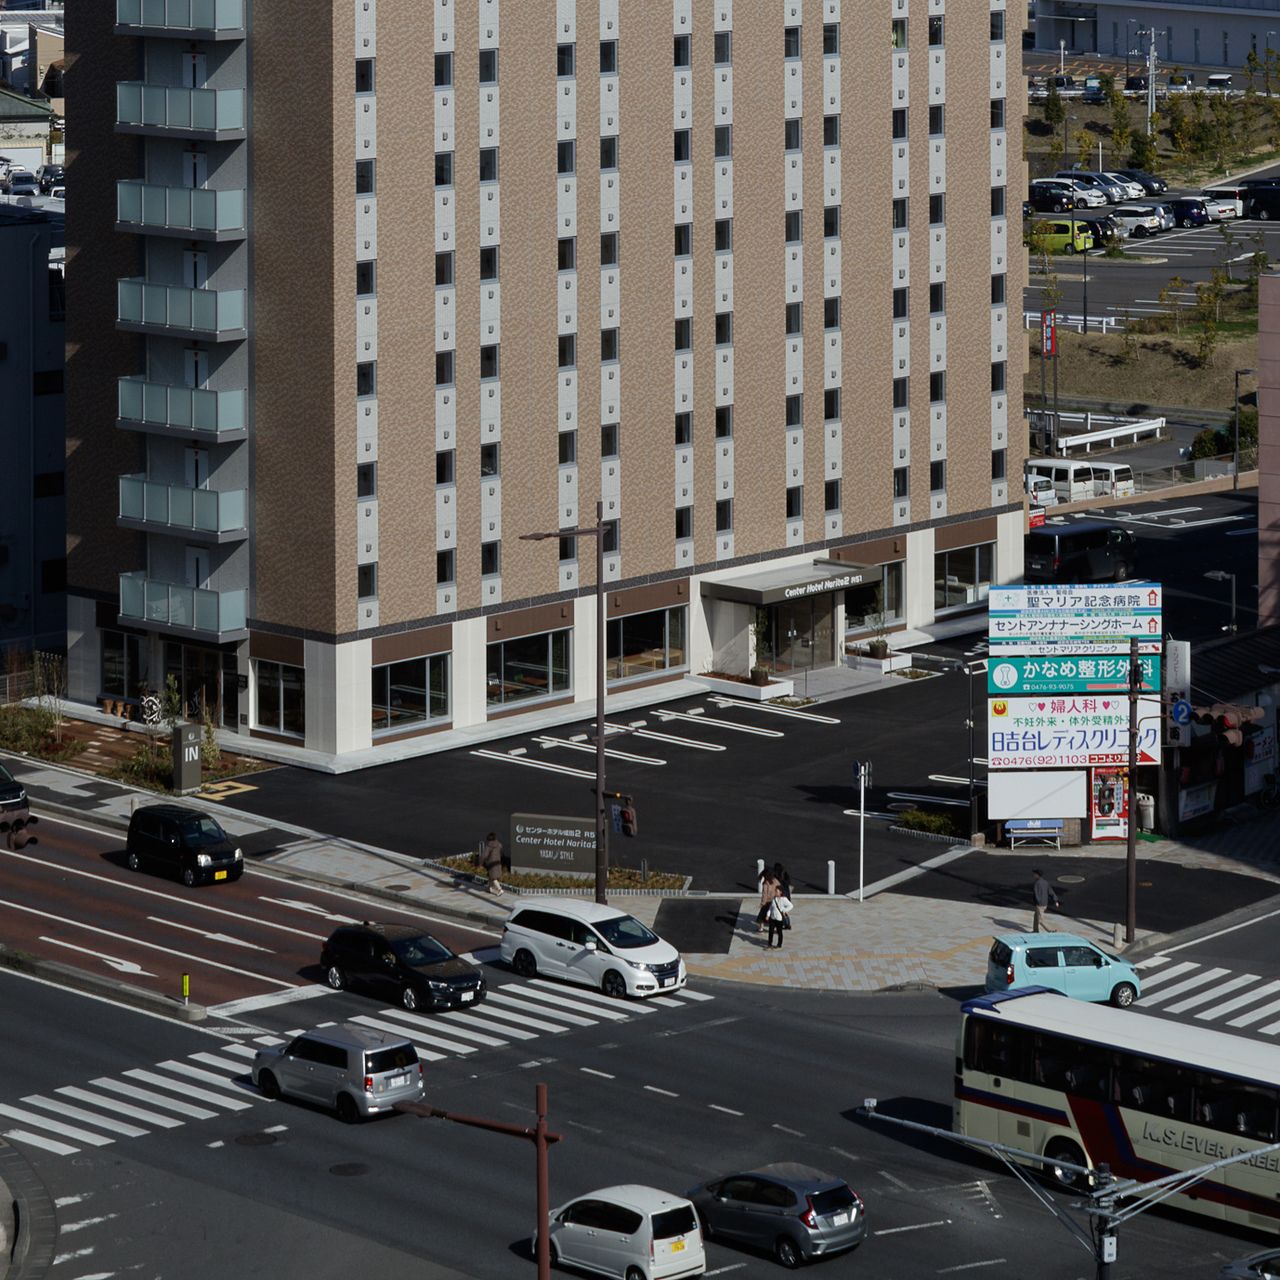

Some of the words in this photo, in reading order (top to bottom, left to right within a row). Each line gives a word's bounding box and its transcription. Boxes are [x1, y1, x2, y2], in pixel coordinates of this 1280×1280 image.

[785, 586, 806, 597] Center
[806, 582, 824, 593] Hotel
[1027, 595, 1141, 608] 聖マリア記念病院
[995, 619, 1142, 632] セントアンナナーシングホーム
[1038, 645, 1118, 654] セントマリアクリニック
[1023, 659, 1153, 679] かなめ整形外科
[1050, 699, 1097, 713] 婦人科
[1178, 704, 1188, 722] 2
[185, 745, 199, 762] IN
[1090, 754, 1142, 763] ココより車分
[1003, 755, 1088, 766] 0476(92)1103
[516, 835, 541, 844] Center
[543, 837, 565, 846] Hotel
[584, 830, 596, 838] R5
